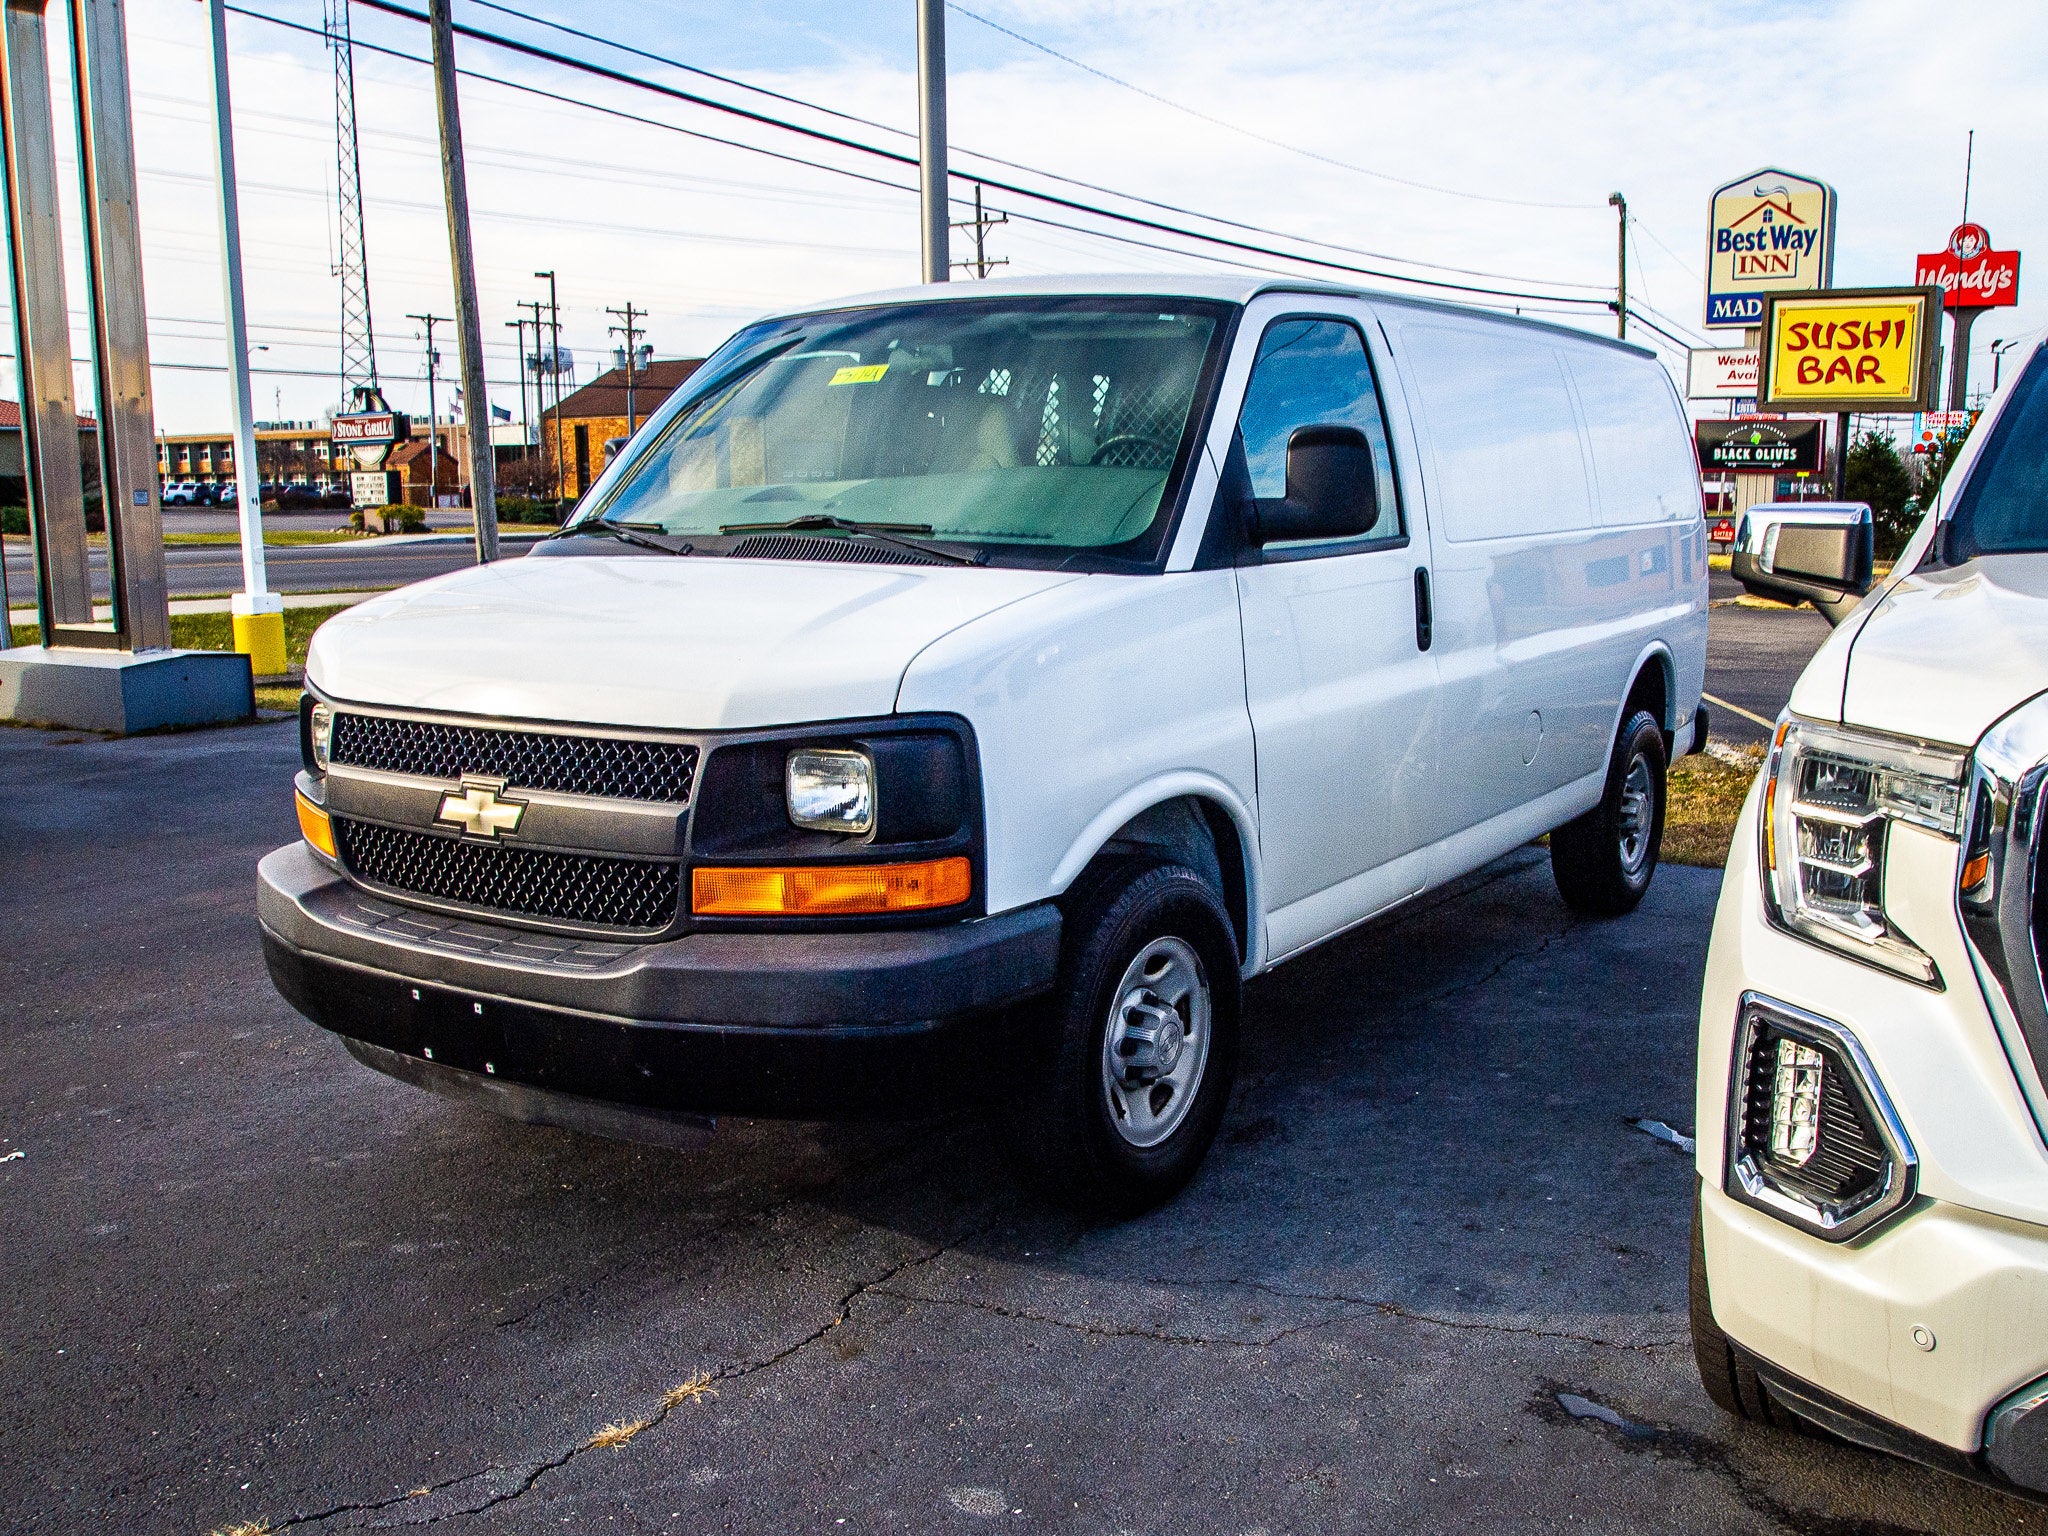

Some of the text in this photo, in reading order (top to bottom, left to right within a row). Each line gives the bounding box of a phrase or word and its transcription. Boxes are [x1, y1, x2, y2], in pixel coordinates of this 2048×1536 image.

[1716, 224, 1819, 257] Best Way
[1738, 253, 1791, 274] INN
[1918, 258, 2013, 298] Wendy's
[1712, 298, 1763, 318] MAD
[1786, 320, 1906, 351] SUSHI
[1717, 354, 1761, 367] Weekly
[1797, 354, 1886, 385] BAR
[336, 420, 389, 438] STONE GRILL
[1713, 447, 1798, 460] BLACK OLIVES
